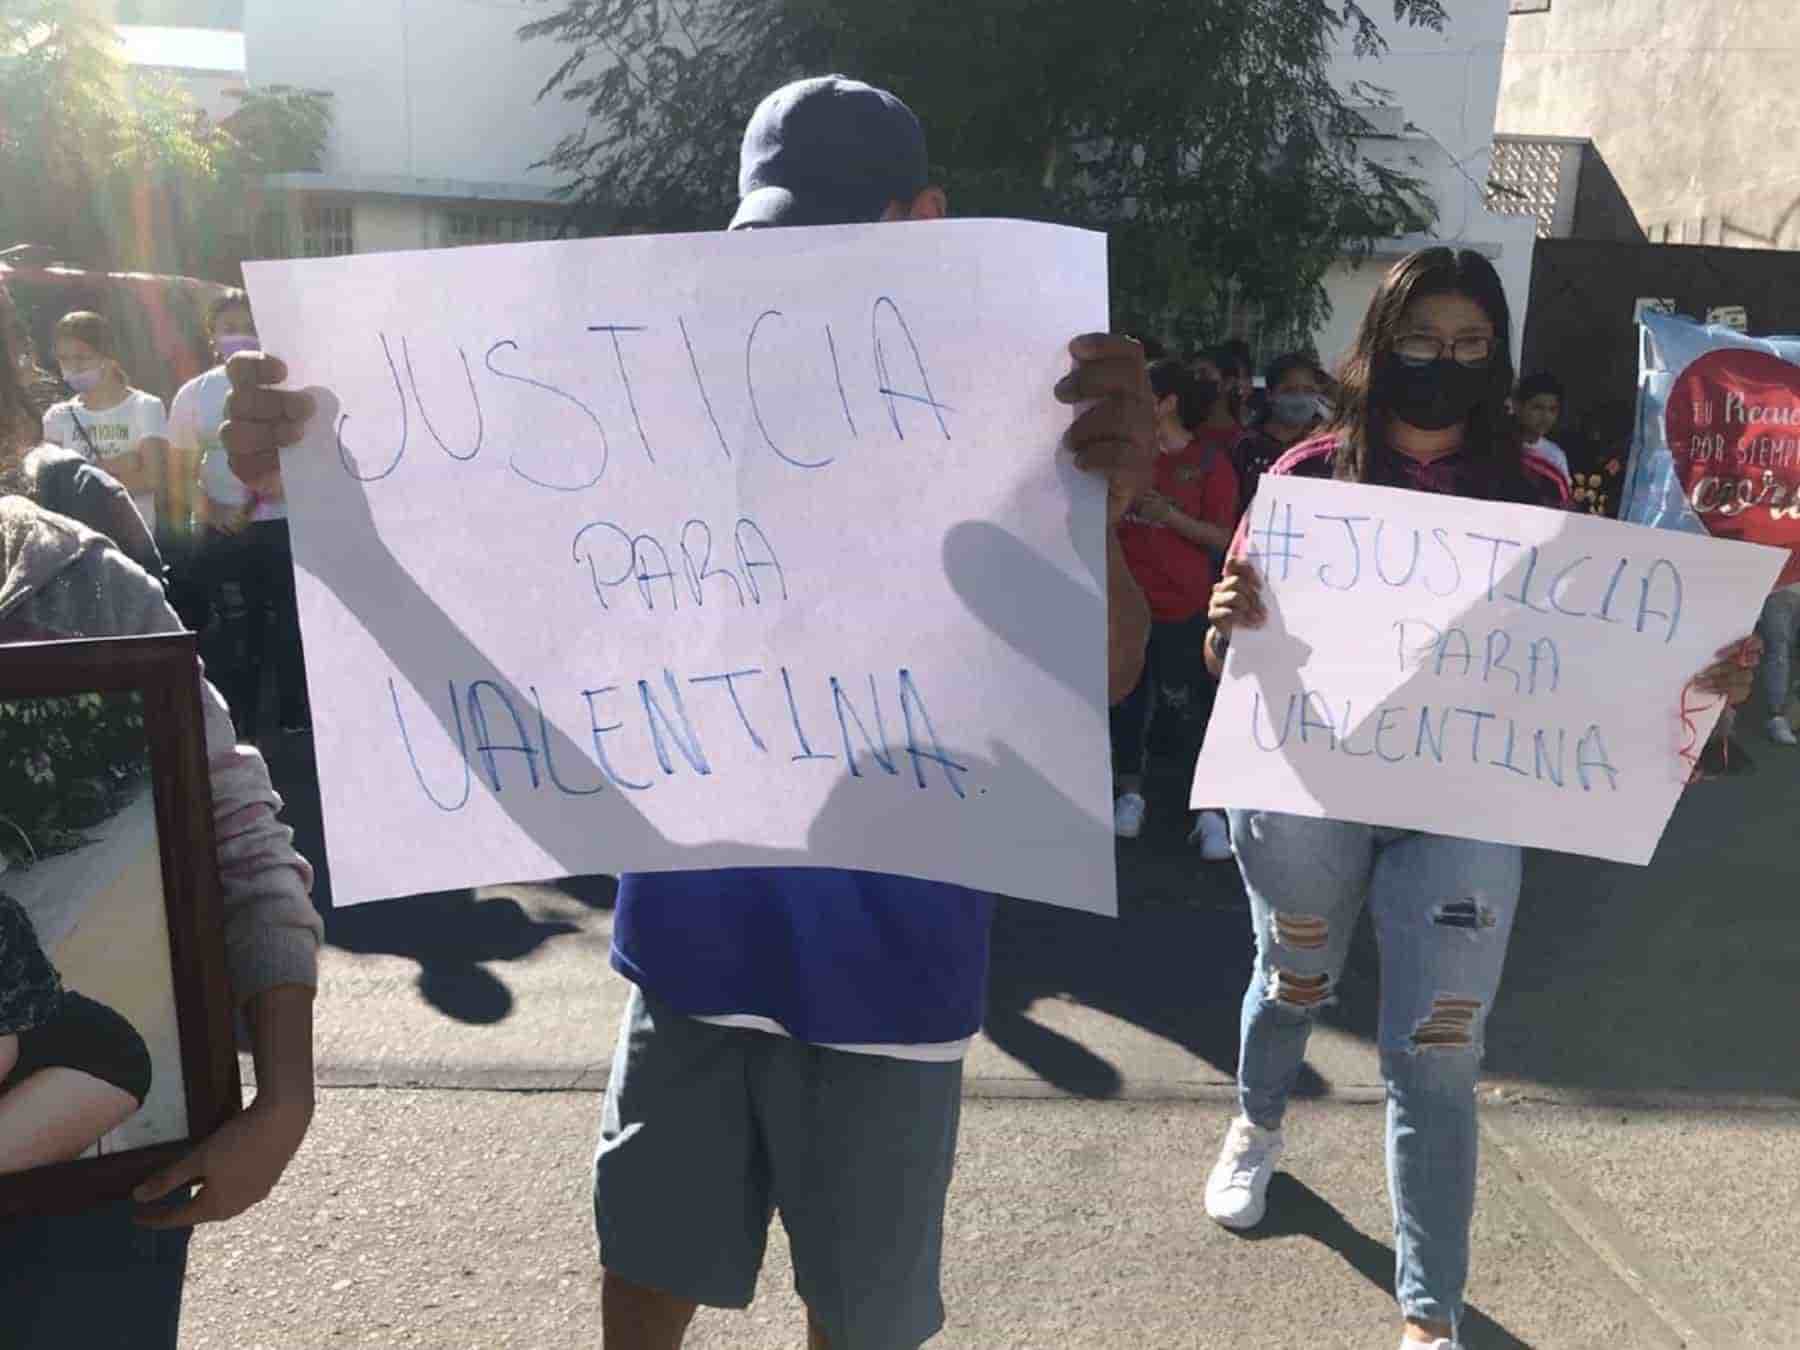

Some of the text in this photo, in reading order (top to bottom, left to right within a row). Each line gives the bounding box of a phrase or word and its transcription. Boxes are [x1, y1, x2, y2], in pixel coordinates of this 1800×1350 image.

[338, 296, 957, 491] JUSTICIA
[1689, 432, 1725, 463] POR
[572, 518, 788, 611] PARA
[1248, 498, 1683, 643] #JUSTICIA
[1394, 620, 1560, 695] PARA
[1252, 689, 1618, 792] VALENTINA
